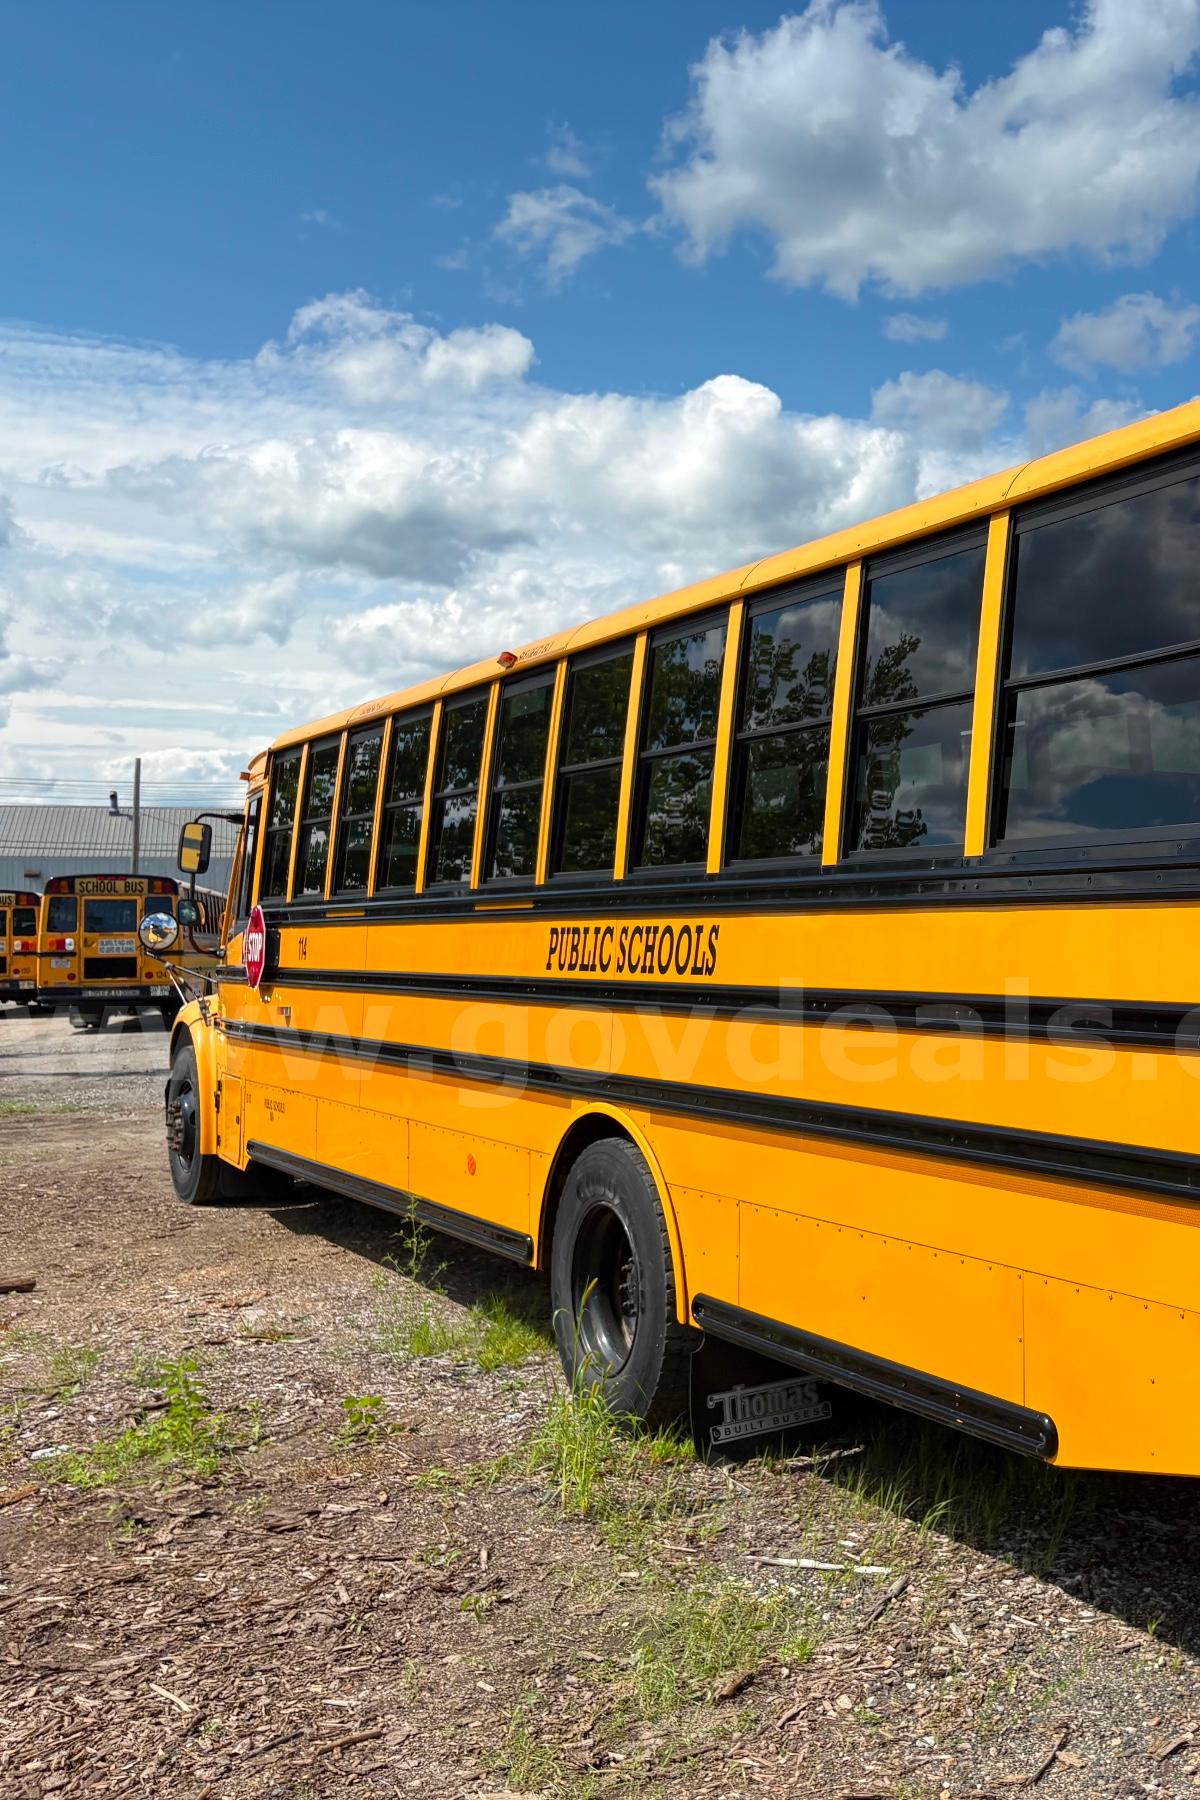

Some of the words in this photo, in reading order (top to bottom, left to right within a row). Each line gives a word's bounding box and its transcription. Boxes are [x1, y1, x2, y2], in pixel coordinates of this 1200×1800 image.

[79, 880, 118, 894] SCHOOL
[124, 880, 144, 893] BUS
[248, 932, 263, 963] STOP
[298, 936, 308, 960] 114
[546, 926, 614, 973] PUBLIC
[616, 924, 720, 976] SCHOOLS
[707, 1376, 829, 1426] Thomas
[724, 1420, 764, 1436] BUILT
[773, 1408, 820, 1425] BUSES
